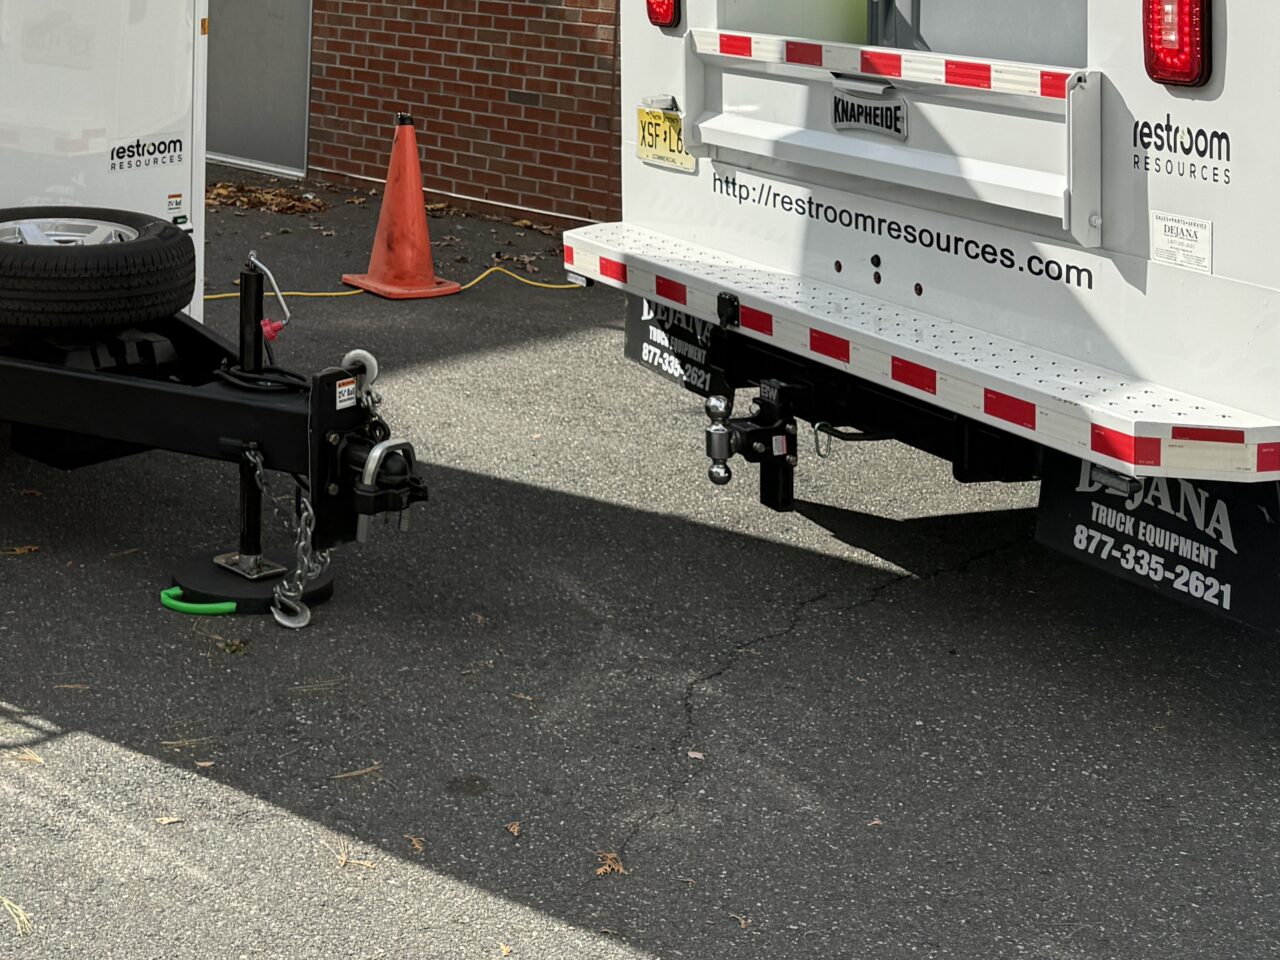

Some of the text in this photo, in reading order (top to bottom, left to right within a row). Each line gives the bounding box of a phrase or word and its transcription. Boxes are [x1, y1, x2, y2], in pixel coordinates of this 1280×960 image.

[833, 95, 902, 135] KNAPHEIDE
[110, 138, 183, 161] restroom
[640, 119, 690, 156] XSF L6
[1133, 113, 1231, 162] restroom
[110, 154, 183, 171] RESOURCES
[1133, 154, 1231, 185] RESOURCES
[712, 172, 1094, 290] http://restroomresources.com
[1163, 223, 1198, 240] DEJANA
[641, 342, 712, 392] 877-335-2621
[1091, 501, 1219, 570] TRUCK EQUIPMENT
[1073, 524, 1232, 611] 877-335-2621
